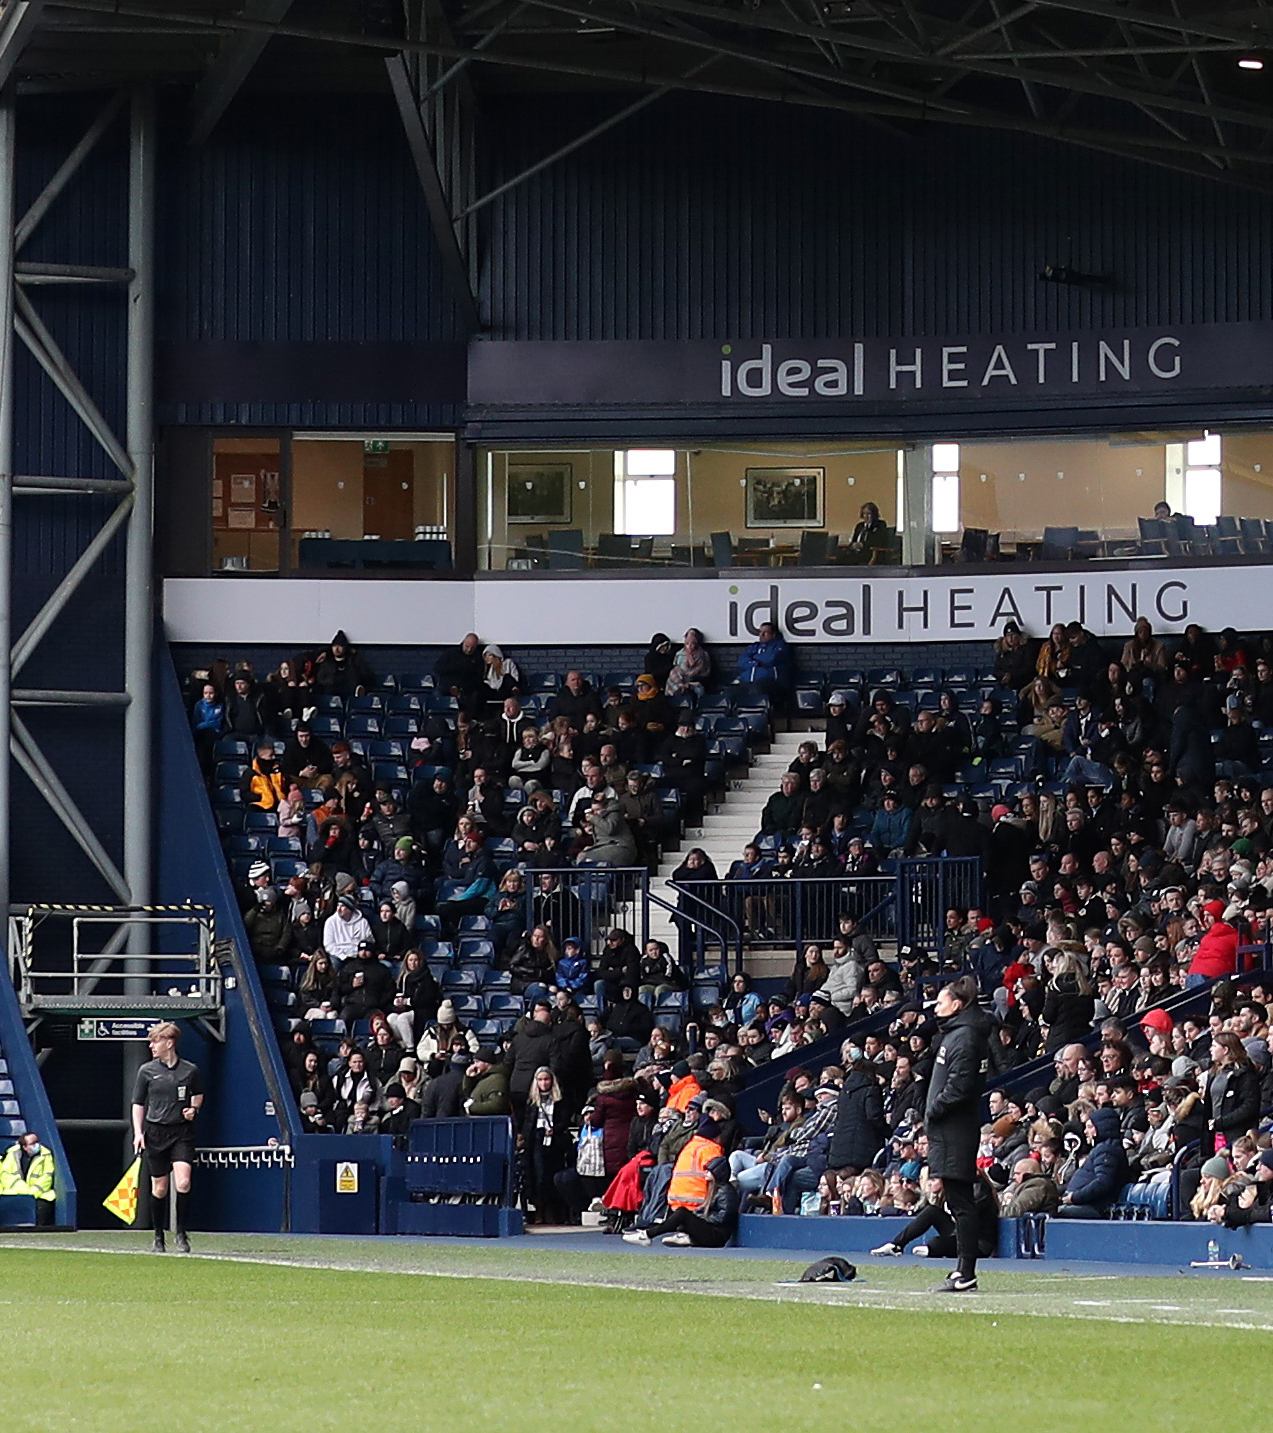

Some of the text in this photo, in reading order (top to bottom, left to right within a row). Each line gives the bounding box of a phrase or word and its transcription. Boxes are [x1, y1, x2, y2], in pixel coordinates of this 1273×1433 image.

[720, 337, 1182, 397] ideal HEATING
[728, 579, 1190, 637] ideal HEATING
